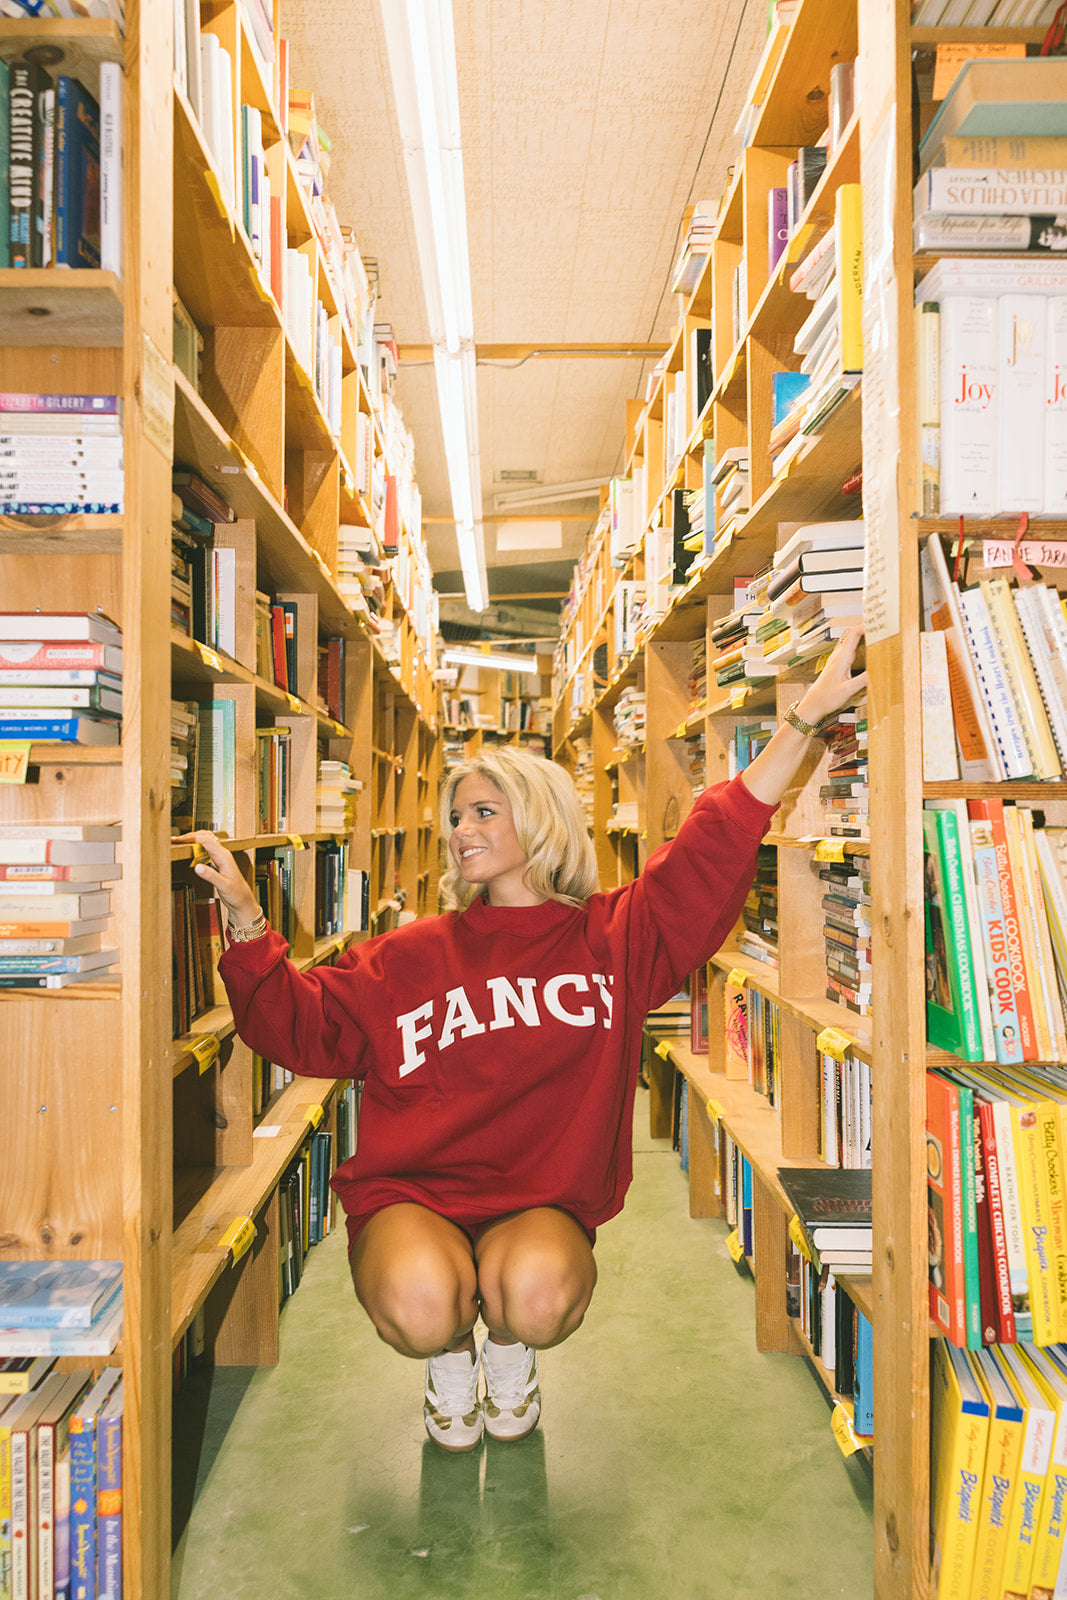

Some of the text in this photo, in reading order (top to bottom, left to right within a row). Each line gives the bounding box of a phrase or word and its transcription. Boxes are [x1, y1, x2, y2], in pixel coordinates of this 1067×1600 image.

[10, 88, 33, 161] CREATIVE
[10, 164, 33, 208] MIND
[946, 187, 1018, 205] CHILD'S
[996, 171, 1065, 185] ITCHEN
[0, 397, 85, 408] LIZABETH GILBERT
[955, 364, 996, 409] joy
[952, 893, 967, 952] CHRISTMAS
[987, 919, 1007, 964] KIDS
[995, 843, 1027, 993] Betty Crocker's COOKBOOK
[957, 951, 973, 1012] COOKBOOK
[994, 966, 1014, 1016] COOK
[396, 973, 614, 1079] FANCY
[952, 1148, 961, 1179] DINNER
[953, 1179, 961, 1193] FOR
[987, 1154, 1002, 1210] COMPLETE
[1005, 1166, 1016, 1201] BAKING
[954, 1194, 962, 1216] TWO
[1009, 1203, 1018, 1222] FOR
[1032, 1183, 1042, 1223] ULTIMATE
[1043, 1118, 1067, 1304] Betty Crocker's Microwave Cookbook
[954, 1216, 963, 1264] COOKBOOK
[992, 1210, 1006, 1252] CHICKEN
[1011, 1224, 1021, 1255] TODAY
[1031, 1225, 1049, 1275] Bisquick
[996, 1252, 1011, 1316] COOKBOOK
[1041, 1276, 1051, 1323] COOKBOOK
[14, 1441, 26, 1523] THE VALUE IN THE VALLEY
[41, 1435, 52, 1514] THE VALUE IN THE VALLEY
[956, 1469, 978, 1524] Bisquick
[989, 1474, 1010, 1529] Bisquick
[1021, 1481, 1041, 1533] Bisquick
[1049, 1474, 1067, 1526] Bisquick
[950, 1524, 968, 1598] COOKBOOK
